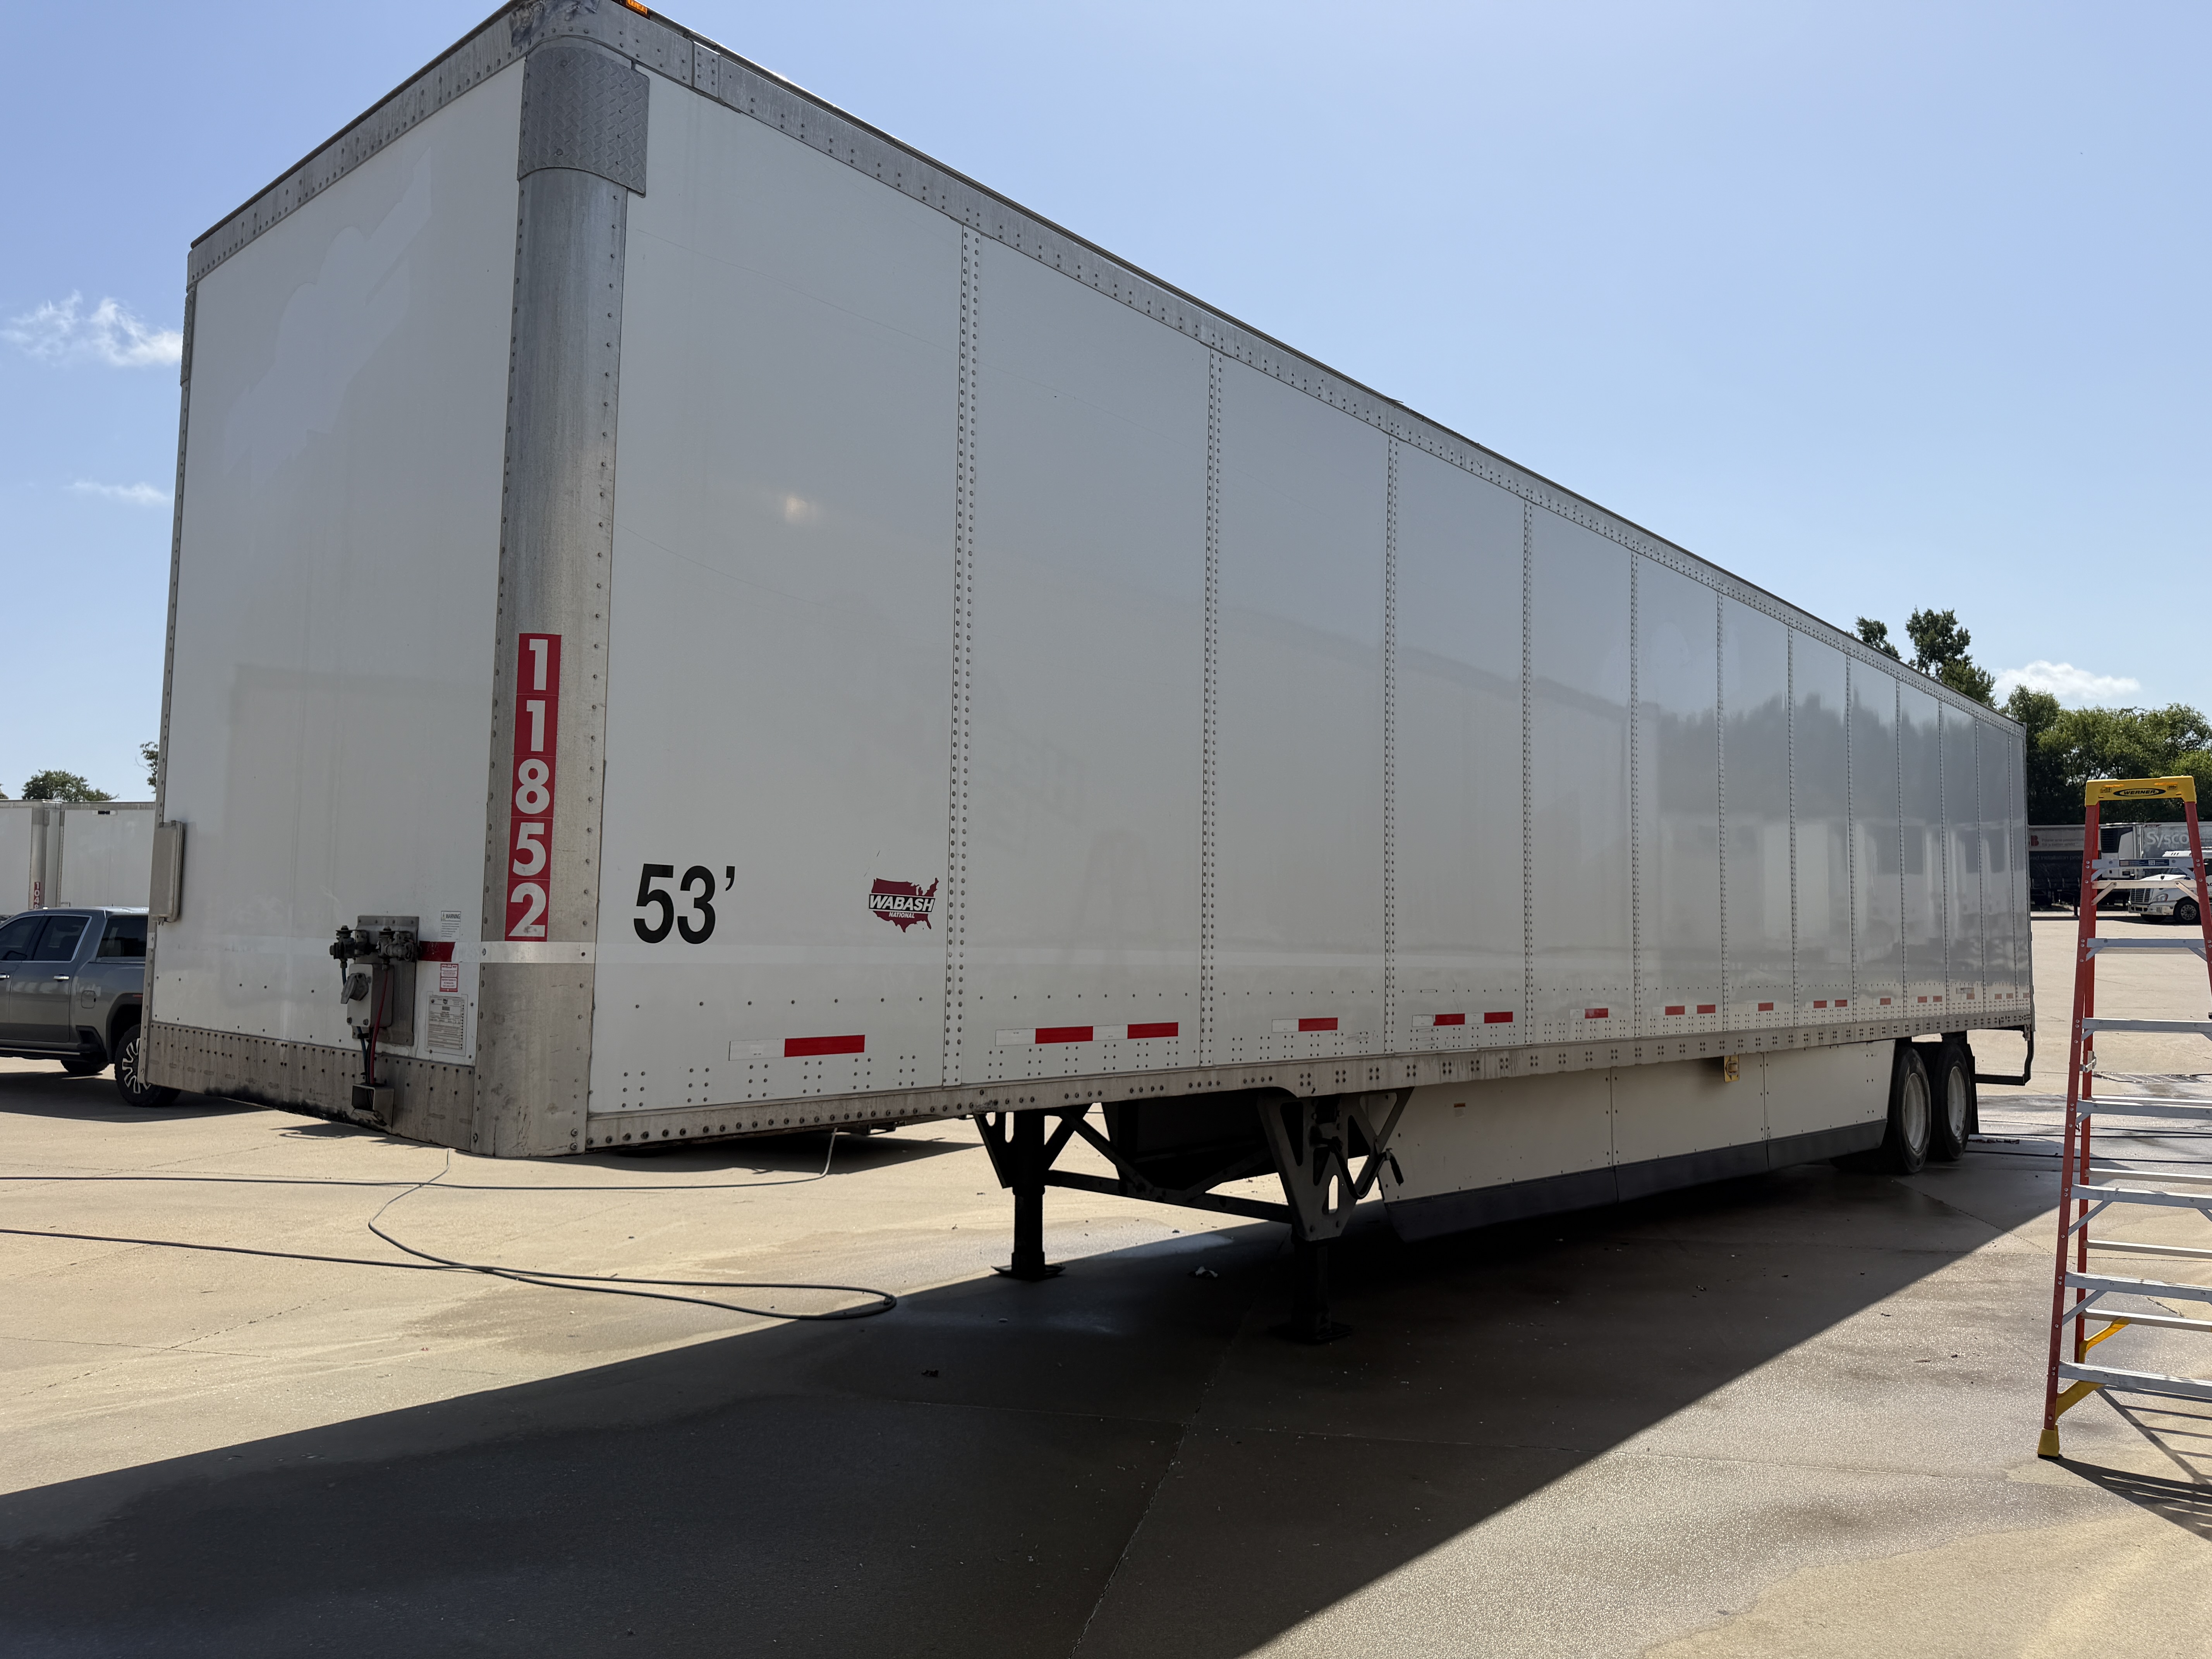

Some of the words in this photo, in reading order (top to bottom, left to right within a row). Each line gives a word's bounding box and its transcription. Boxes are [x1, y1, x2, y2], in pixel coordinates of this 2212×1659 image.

[508, 638, 550, 937] 11852
[2147, 831, 2189, 848] Sysco
[870, 895, 934, 912] WABASH
